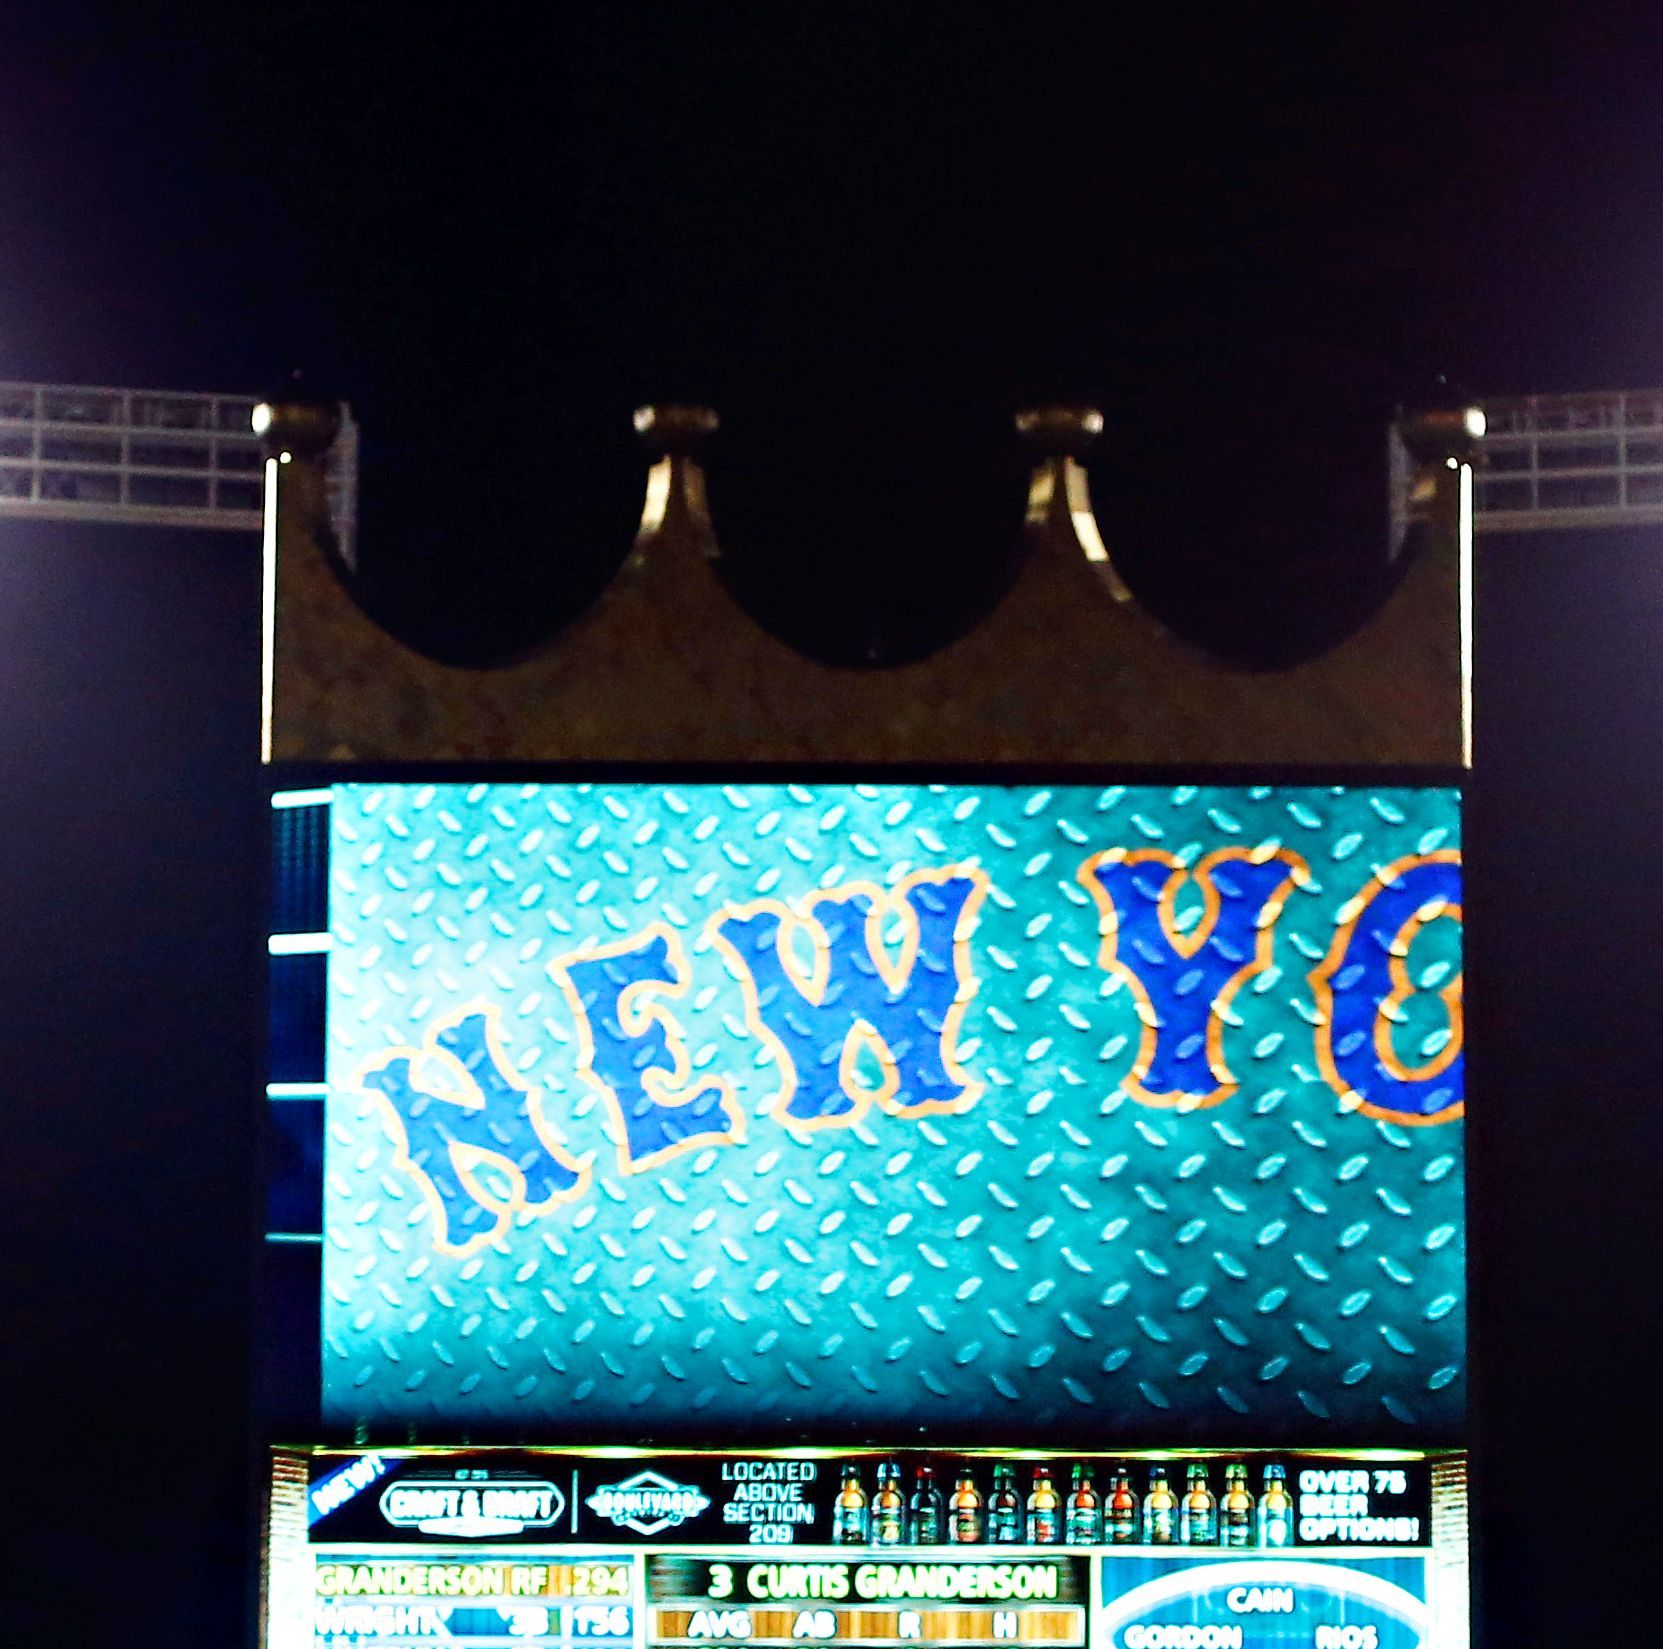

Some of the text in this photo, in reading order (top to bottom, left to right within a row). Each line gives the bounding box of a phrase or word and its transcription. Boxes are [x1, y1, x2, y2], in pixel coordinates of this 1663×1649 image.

[354, 866, 991, 1257] NEW
[722, 1462, 815, 1481] LOCATED
[1299, 1469, 1370, 1494] OVER
[733, 1483, 802, 1502] ABOVE
[723, 1503, 814, 1524] SECTION
[749, 1524, 793, 1544] 209
[315, 1565, 629, 1596] GRANDERSON RF .294
[709, 1565, 1057, 1599] 3 CURTIS GRANDERSON
[1225, 1587, 1294, 1614] CAIN
[687, 1610, 1018, 1640] AVG AB R H
